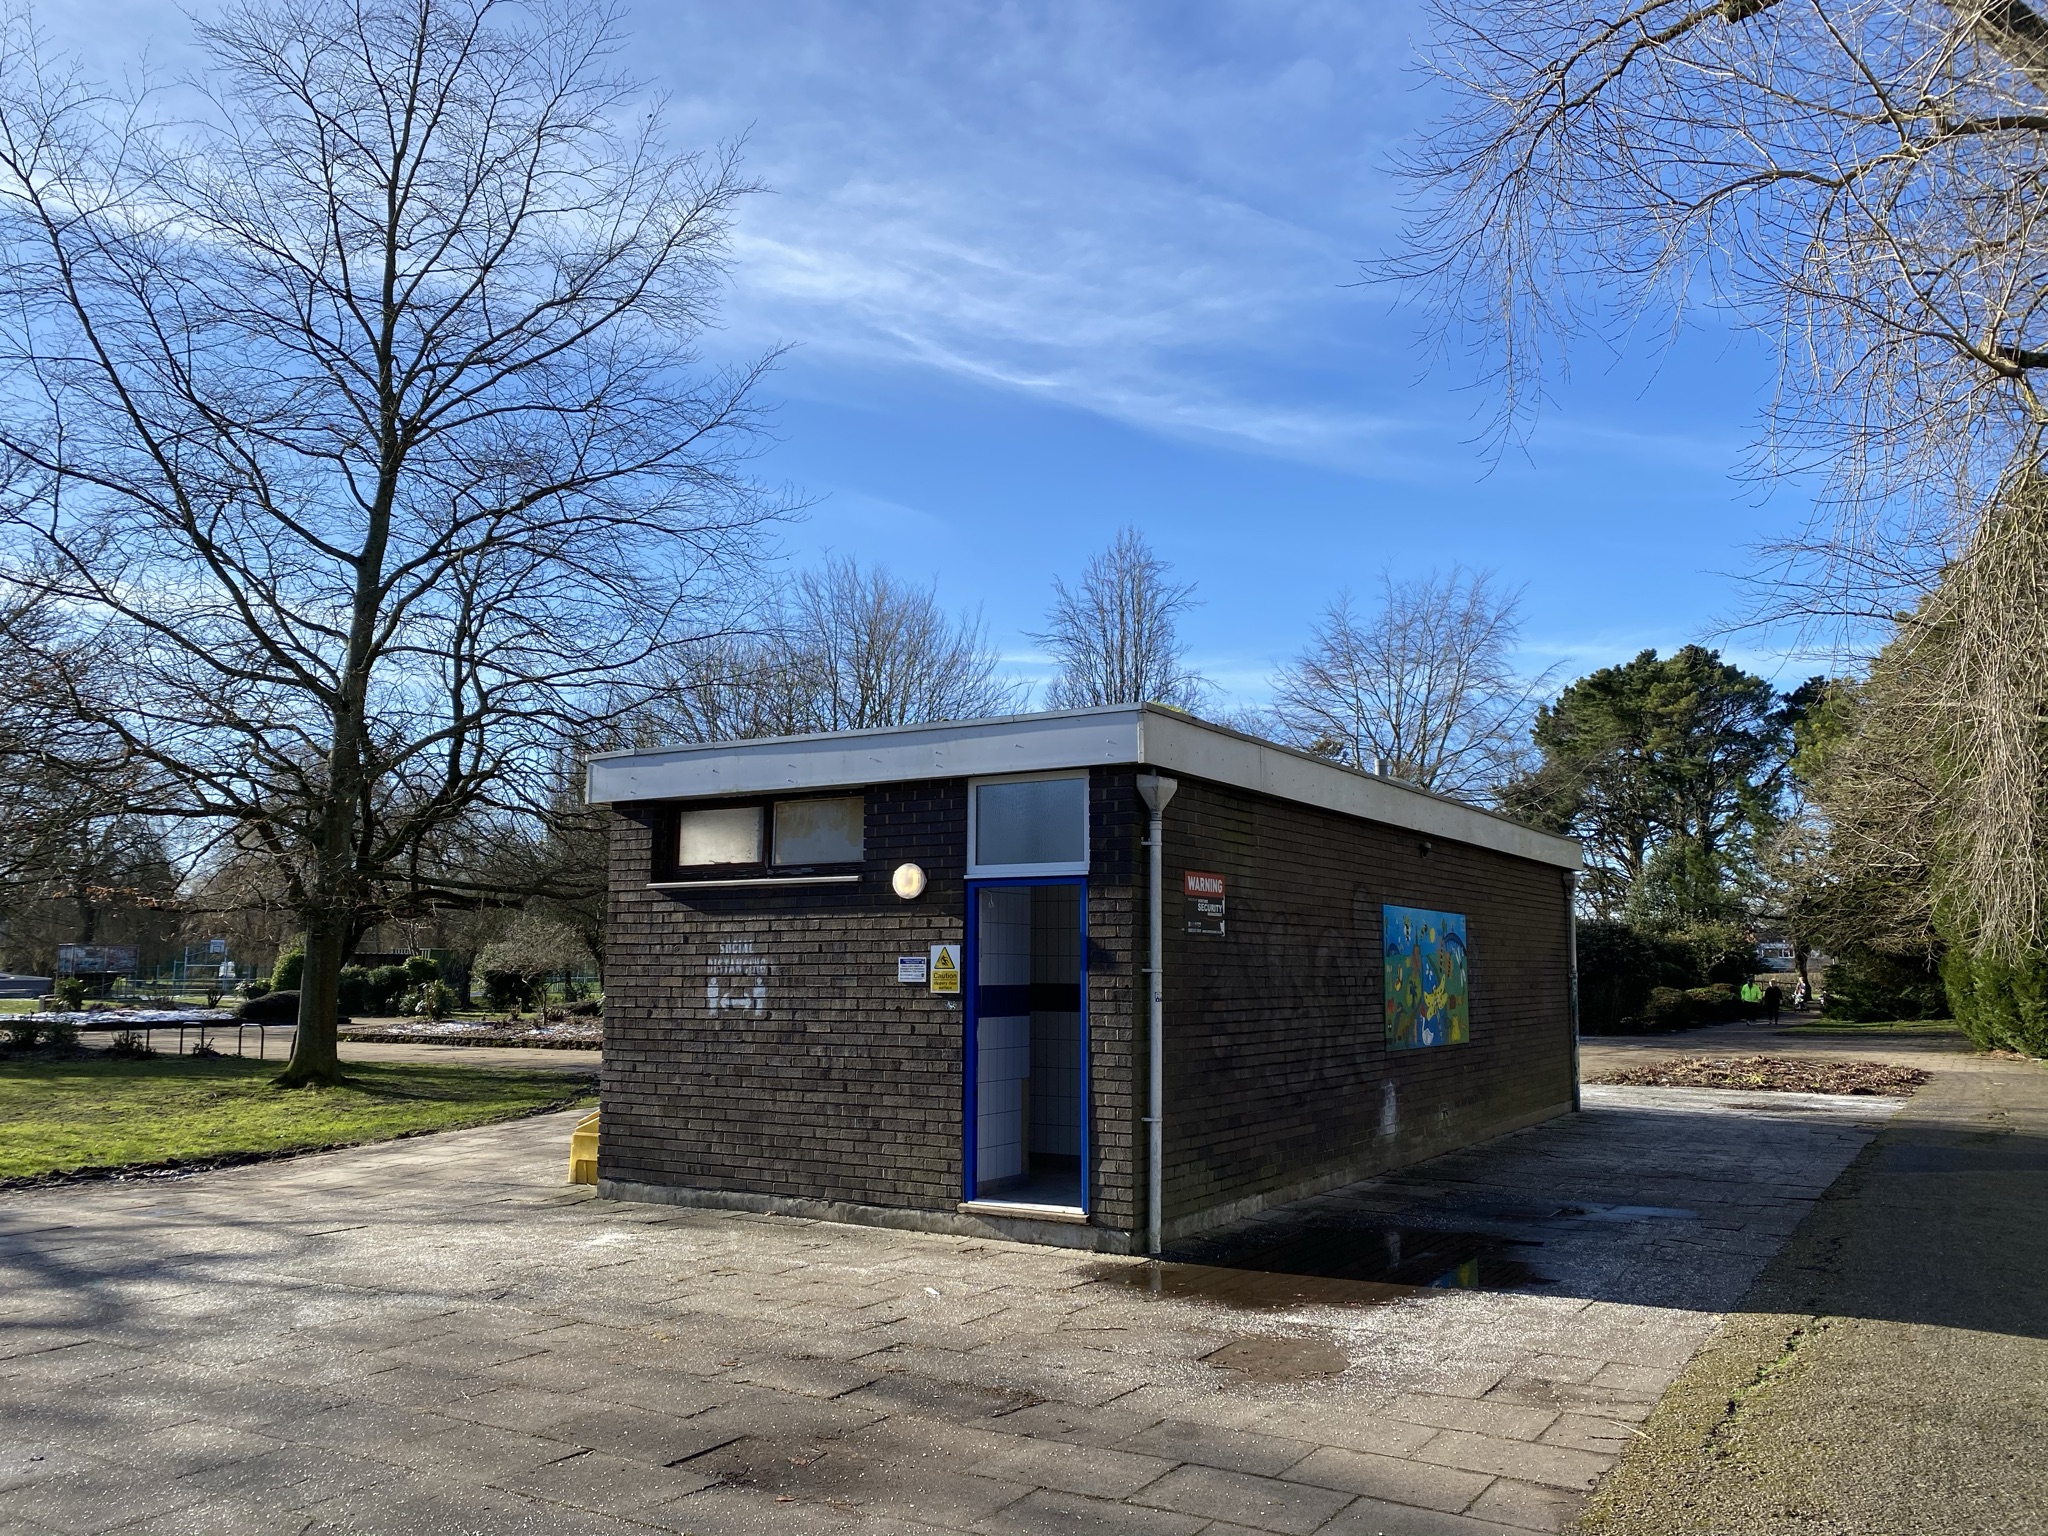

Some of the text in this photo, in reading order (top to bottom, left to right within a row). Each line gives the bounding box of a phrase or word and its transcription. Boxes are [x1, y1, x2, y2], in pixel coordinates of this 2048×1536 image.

[1187, 876, 1223, 893] WARNING
[1197, 903, 1222, 912] SECURITY
[719, 940, 755, 953] SOCIAL
[707, 958, 767, 974] DISTANCING
